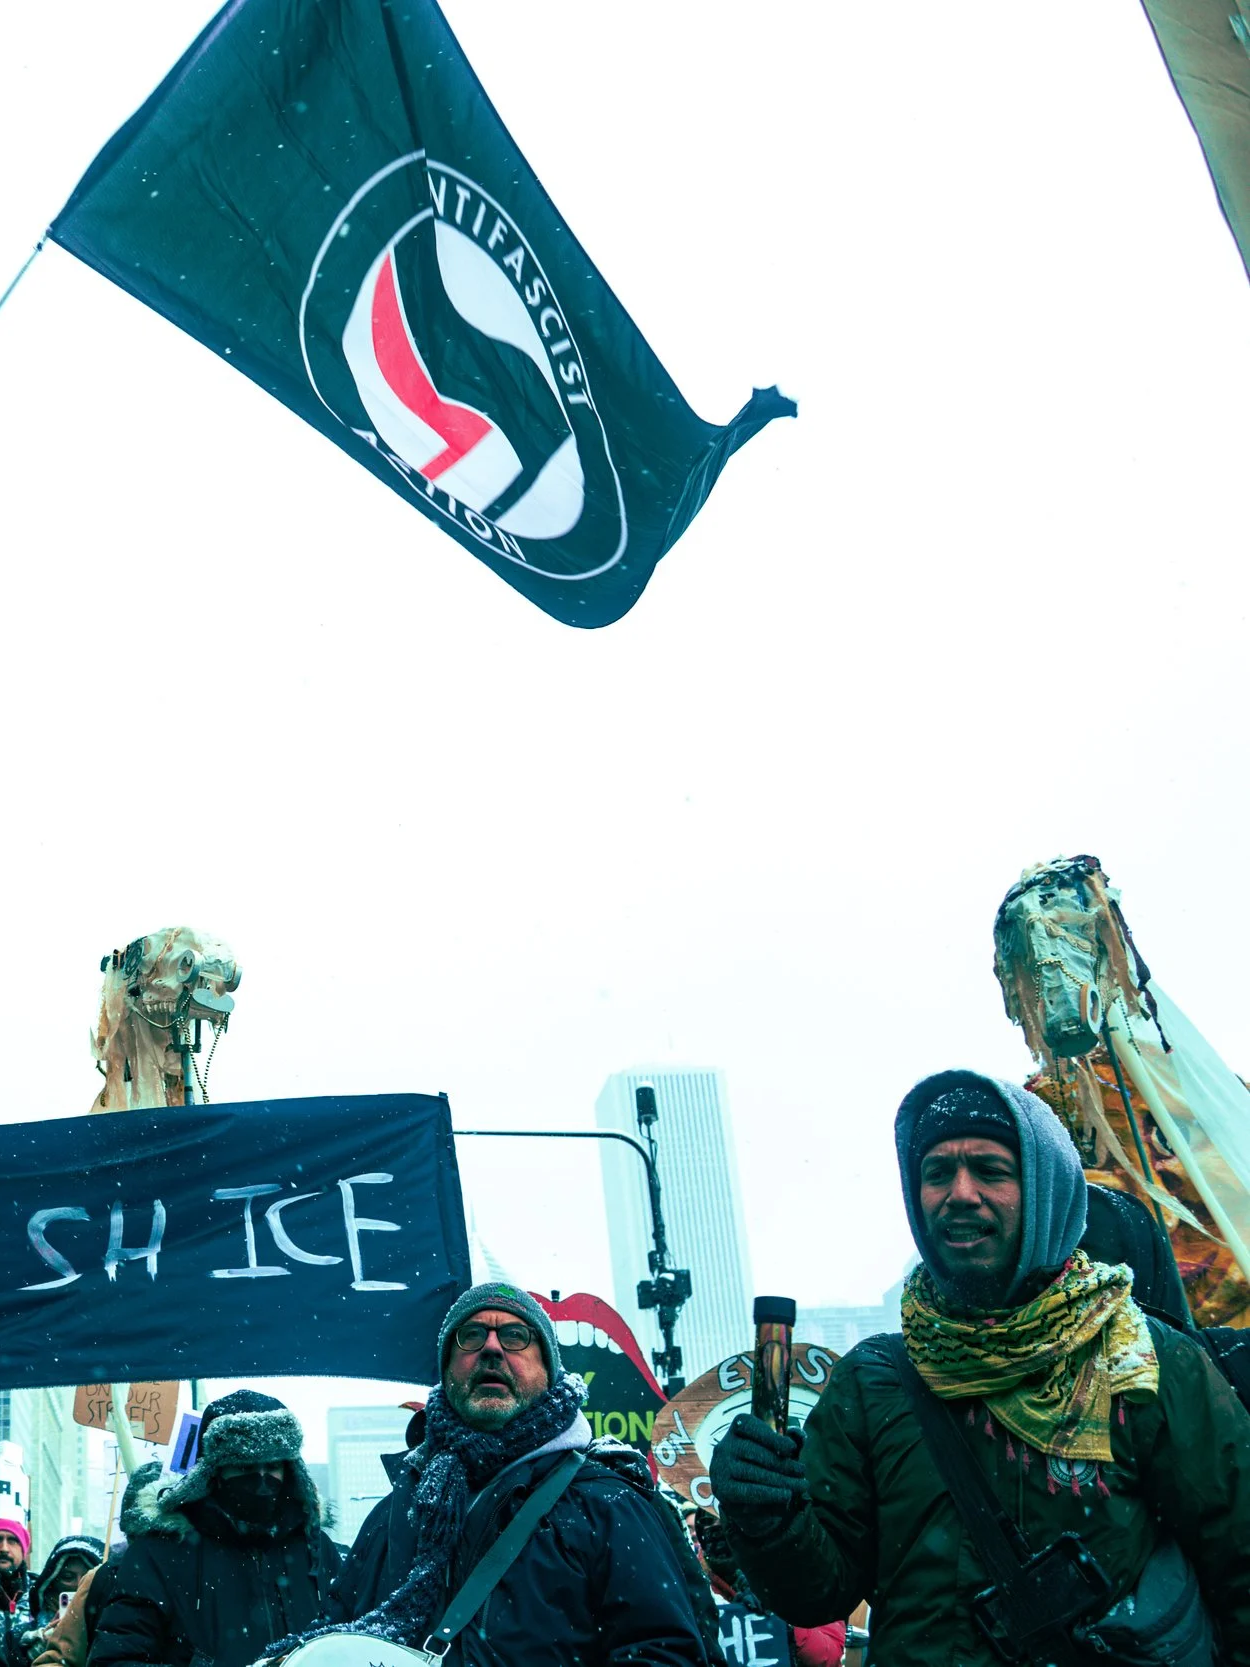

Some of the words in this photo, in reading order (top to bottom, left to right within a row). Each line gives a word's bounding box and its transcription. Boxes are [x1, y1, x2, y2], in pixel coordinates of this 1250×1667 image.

[427, 170, 593, 411] NTIFASCIST
[207, 1172, 410, 1292] ICE
[718, 1347, 835, 1391] ES
[87, 1400, 161, 1434] STRETS
[718, 1608, 779, 1667] HE
